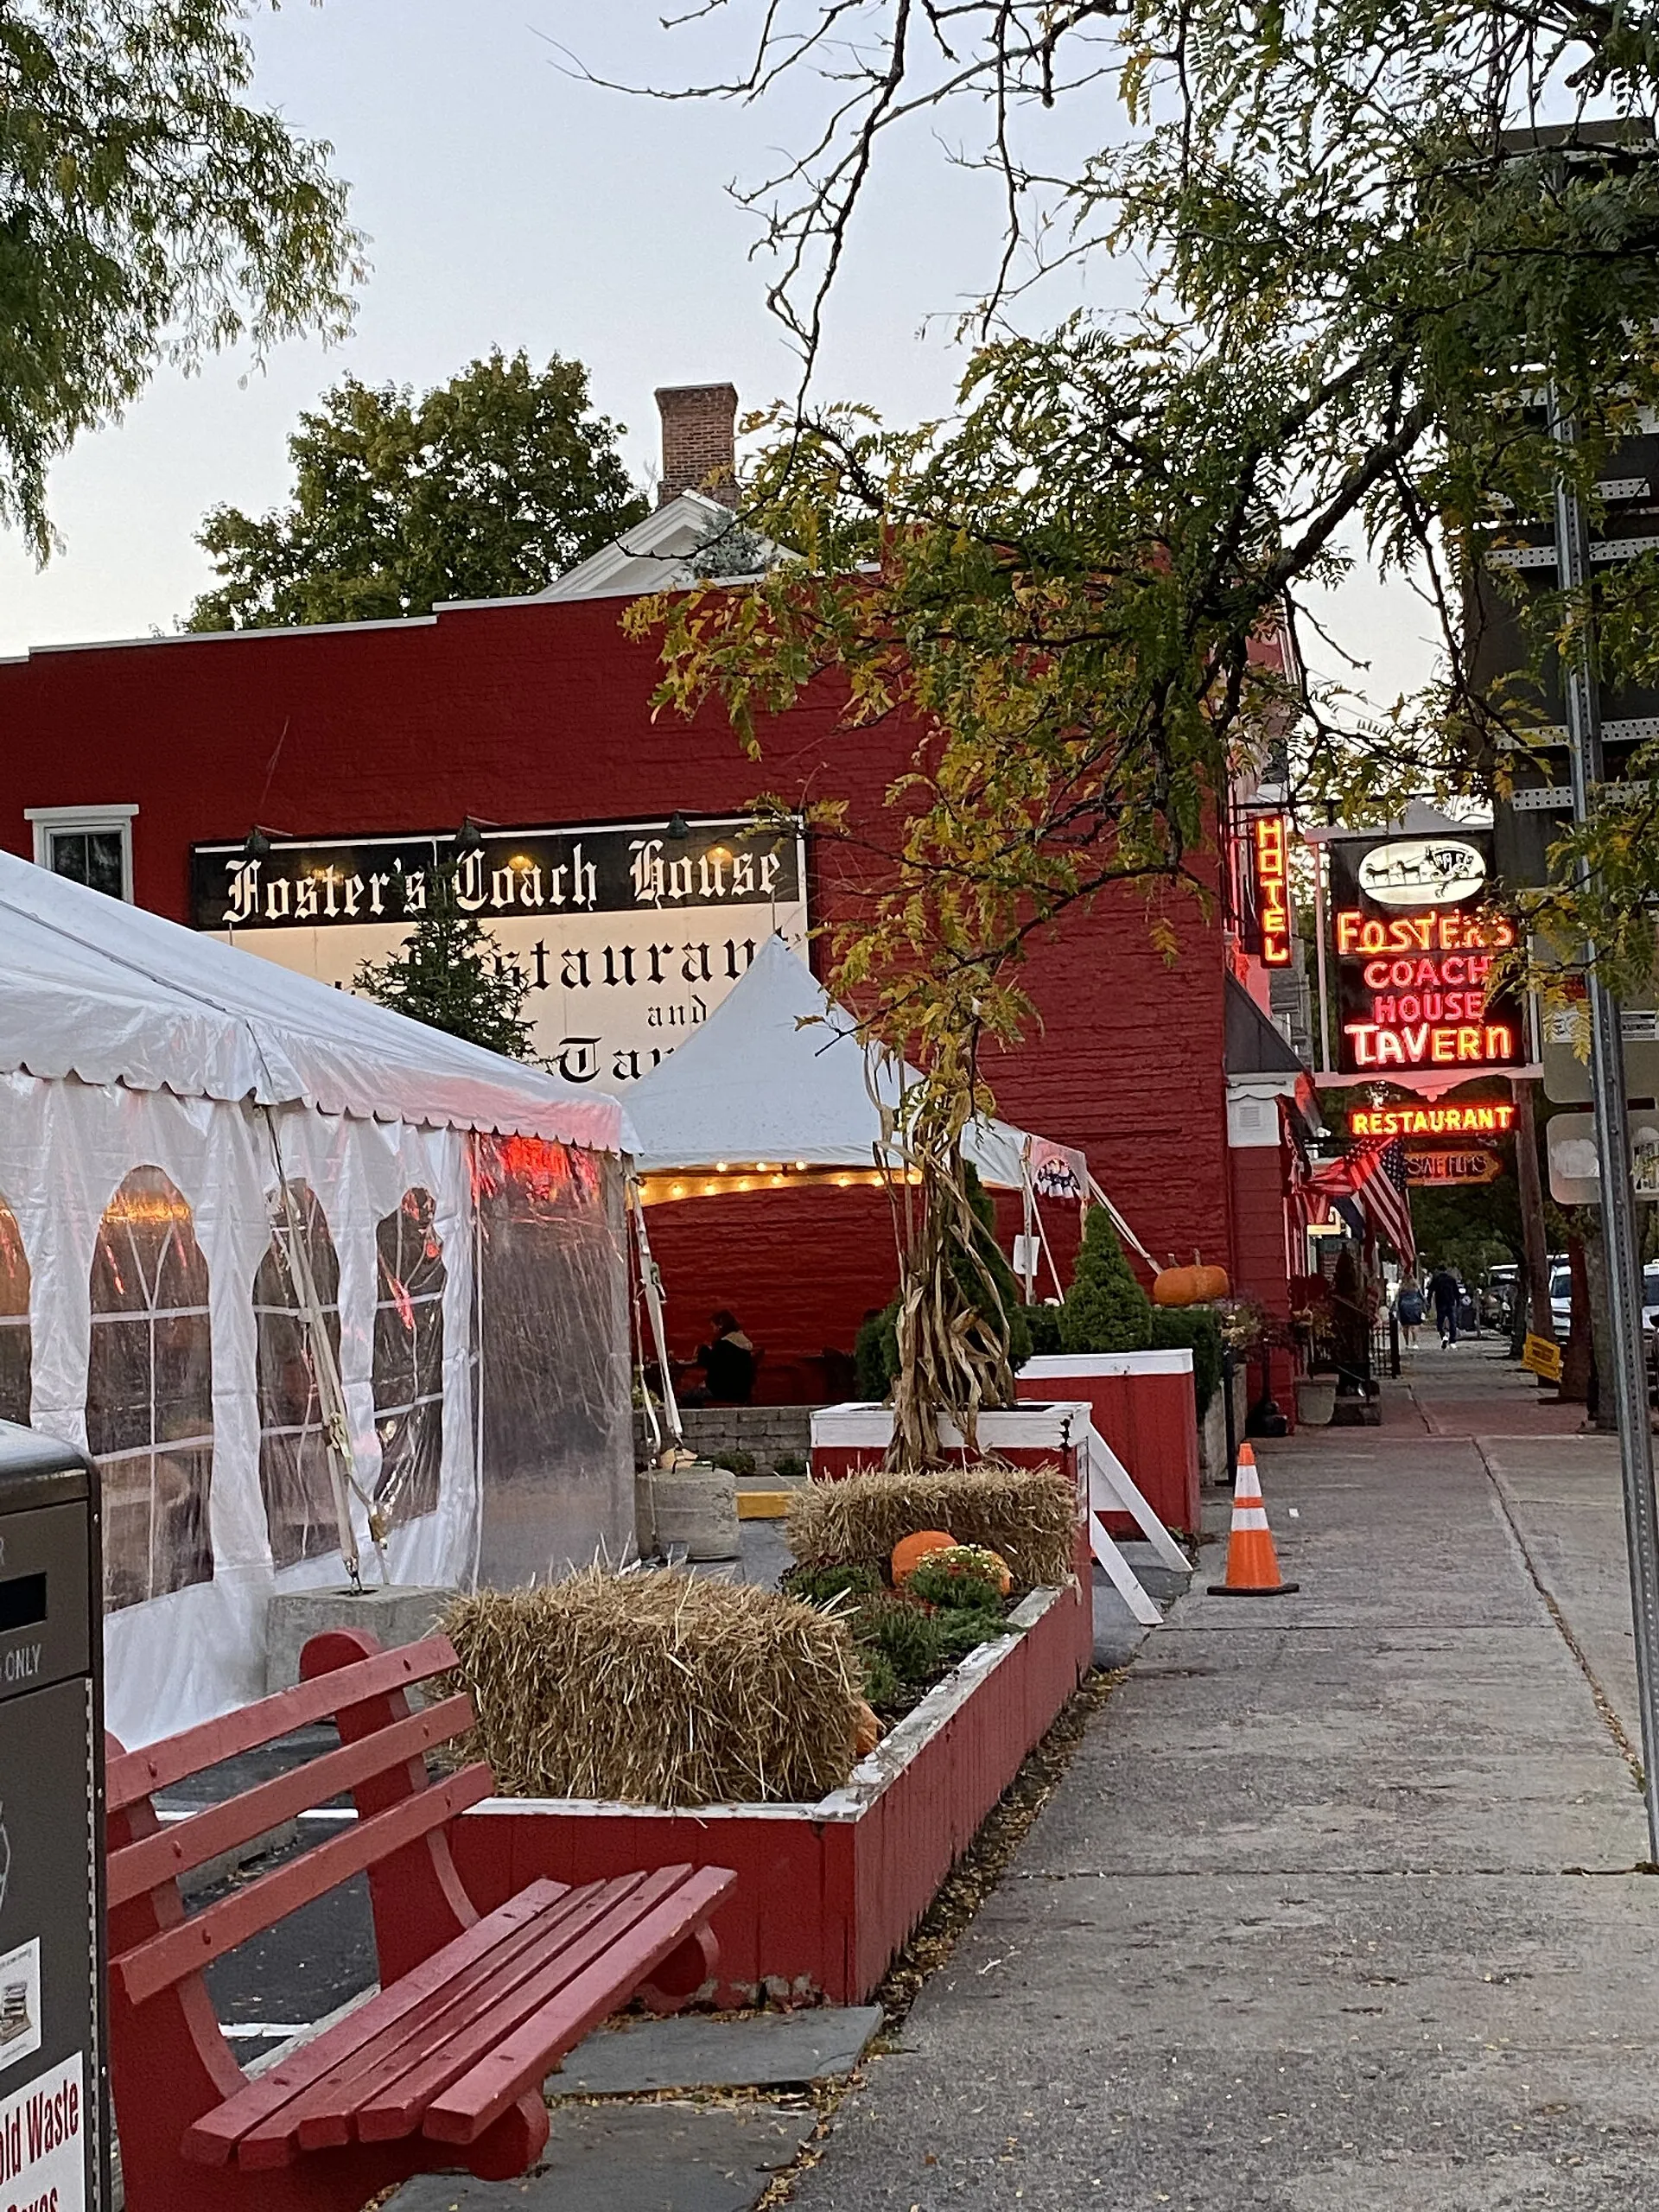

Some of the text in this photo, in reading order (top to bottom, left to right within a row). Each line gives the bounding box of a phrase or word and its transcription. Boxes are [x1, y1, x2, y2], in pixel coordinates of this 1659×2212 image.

[222, 840, 780, 923] Foster's Coach House
[1258, 819, 1288, 962] HOTEL
[1363, 956, 1491, 988] COACH
[648, 995, 707, 1027] and
[1374, 992, 1484, 1023] HOUSE
[1351, 1107, 1514, 1135] RESTAURANT
[4, 1643, 41, 1681] ONLY
[26, 2079, 79, 2163] Waste
